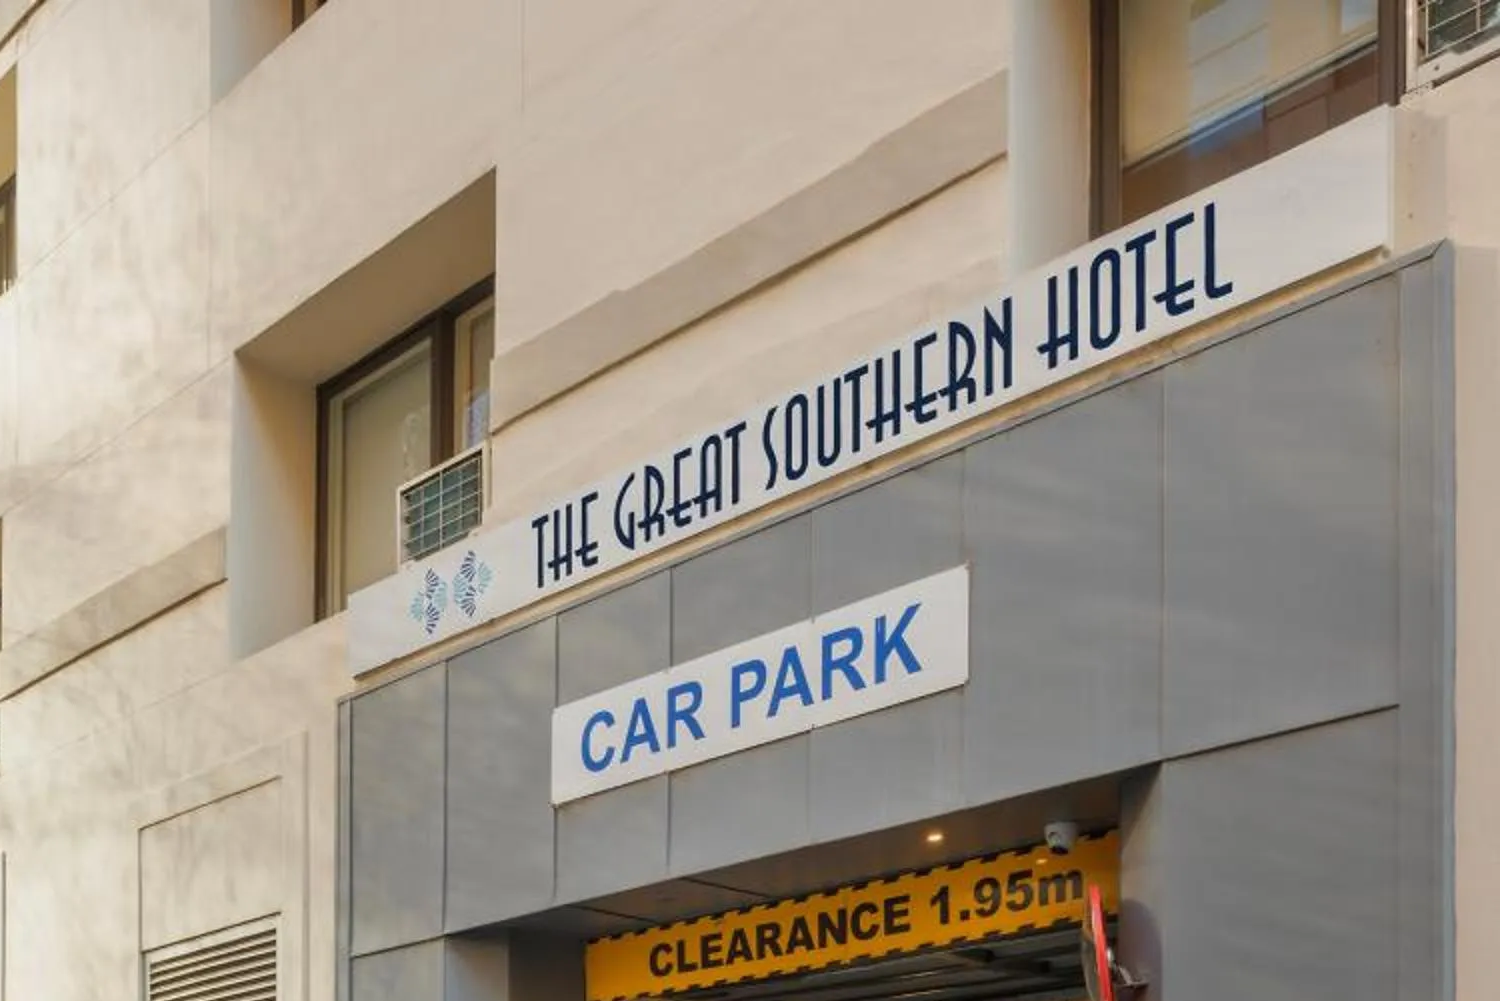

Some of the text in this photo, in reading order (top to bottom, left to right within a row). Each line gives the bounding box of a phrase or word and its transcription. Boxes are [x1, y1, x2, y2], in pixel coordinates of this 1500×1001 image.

[531, 202, 1234, 589] THE GREAT SOUTHERN HOTEL
[579, 602, 923, 774] CAR PARK
[648, 868, 1084, 978] CLEARANCE 1.95m
